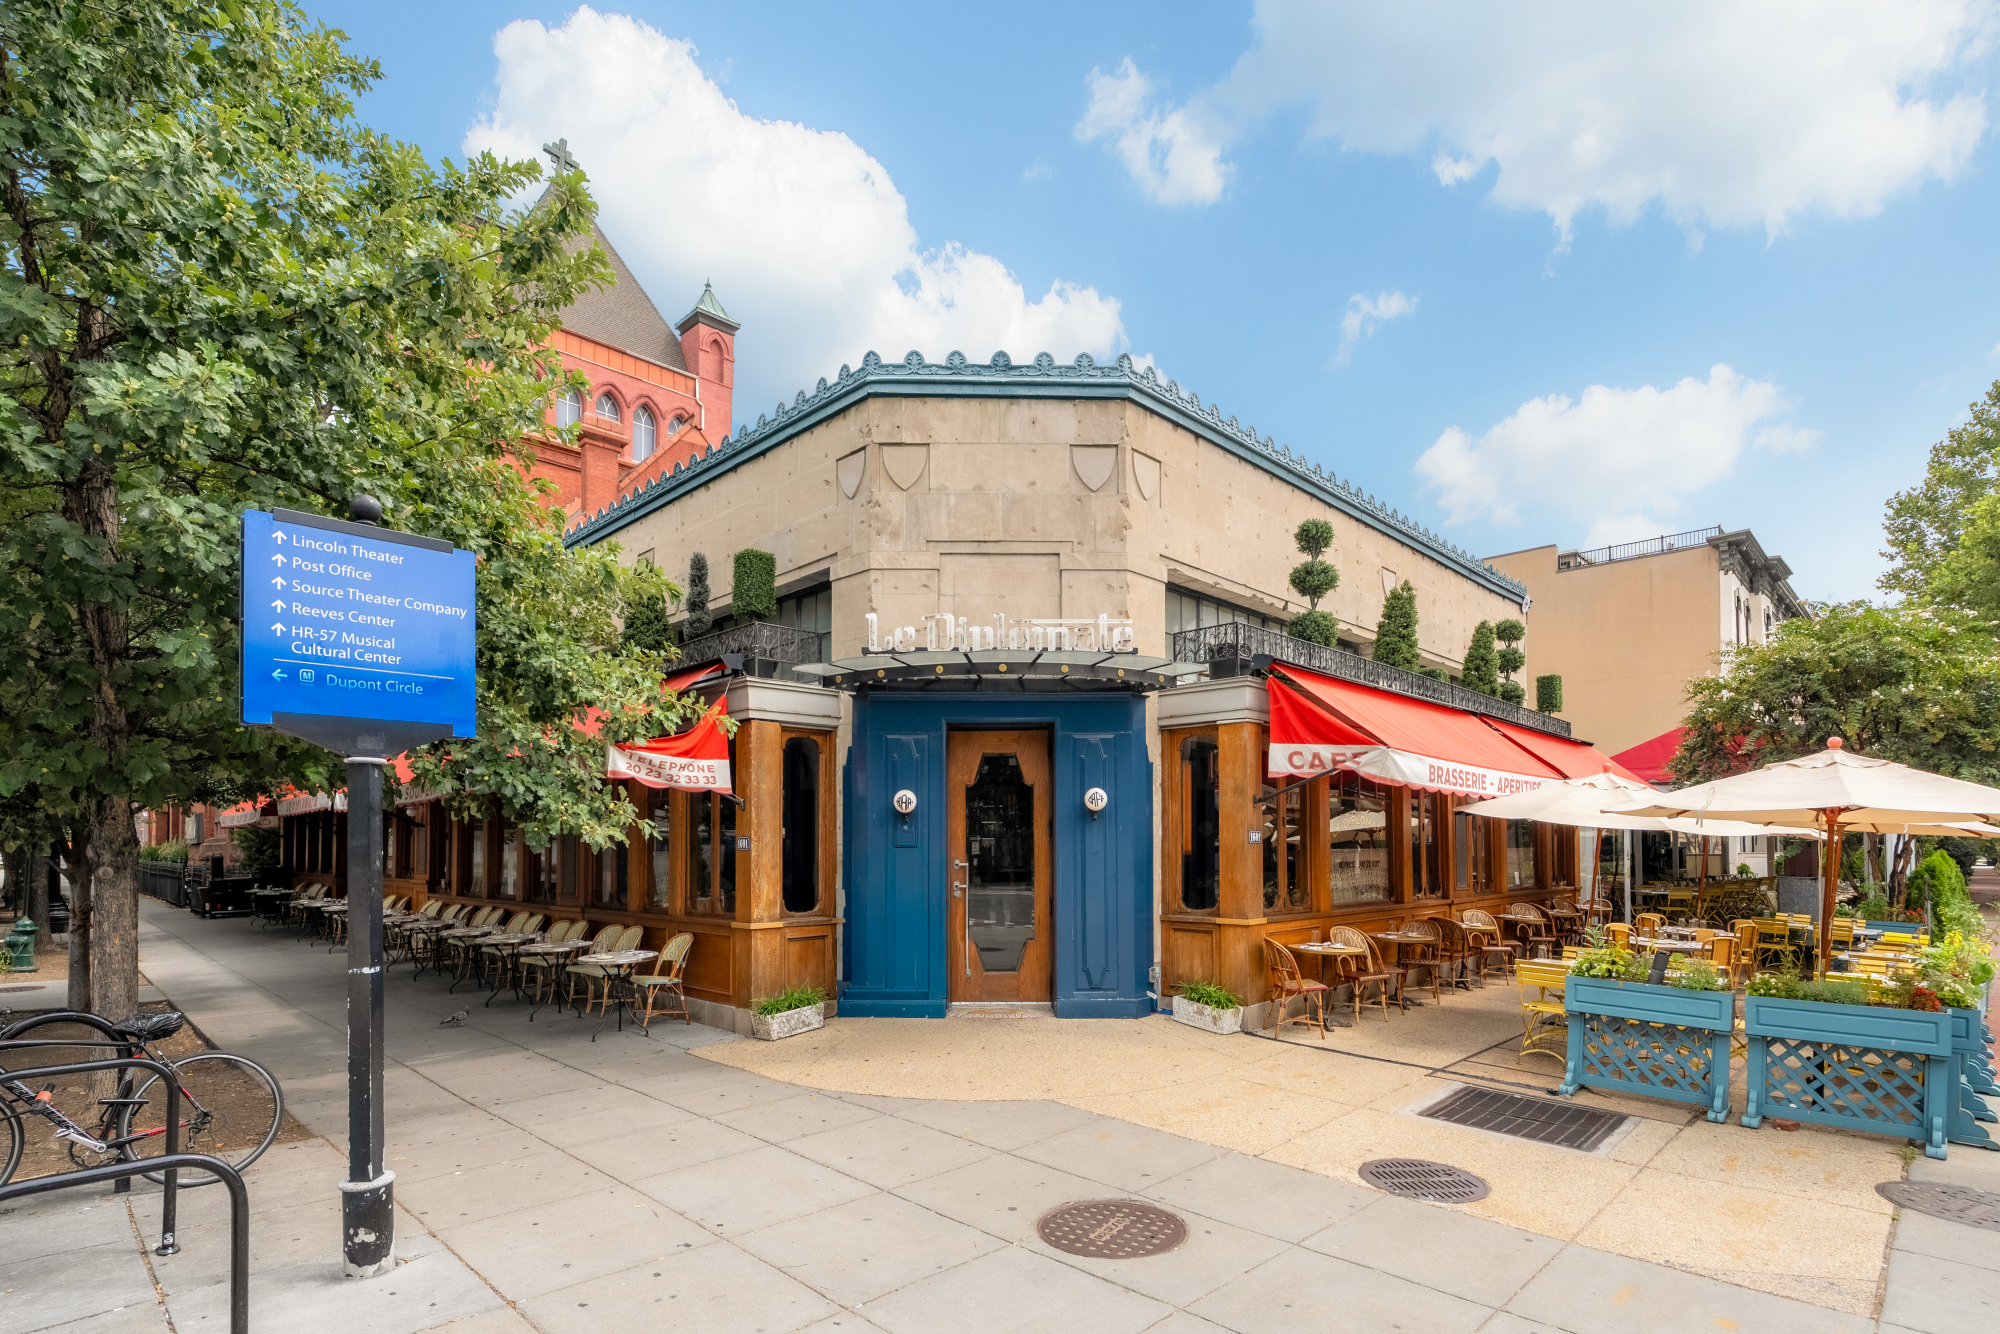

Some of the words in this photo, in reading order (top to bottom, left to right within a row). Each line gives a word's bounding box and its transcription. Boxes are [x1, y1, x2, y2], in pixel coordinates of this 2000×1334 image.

[293, 534, 347, 555] Lincoln
[350, 544, 404, 565] Theater
[292, 557, 325, 574] Post
[328, 563, 372, 581] Office
[292, 579, 344, 599] Source
[346, 587, 401, 607] Theater
[404, 597, 467, 619] Company
[292, 602, 344, 621] Reeves
[348, 610, 396, 627] Center
[292, 625, 338, 642] HR-57
[341, 632, 395, 649] Musical
[865, 612, 915, 651] Le
[921, 612, 1133, 651] Diplomate
[291, 641, 350, 659] Cultural
[354, 649, 402, 665] Center
[326, 674, 382, 690] Dupont
[385, 680, 423, 695] Circle
[625, 761, 642, 774] 20
[645, 767, 662, 778] 23
[665, 773, 681, 784] 32
[685, 775, 700, 784] 33
[702, 775, 717, 785] 33
[626, 751, 715, 774] TELEPHONE
[1428, 763, 1487, 791] BRASSERIE
